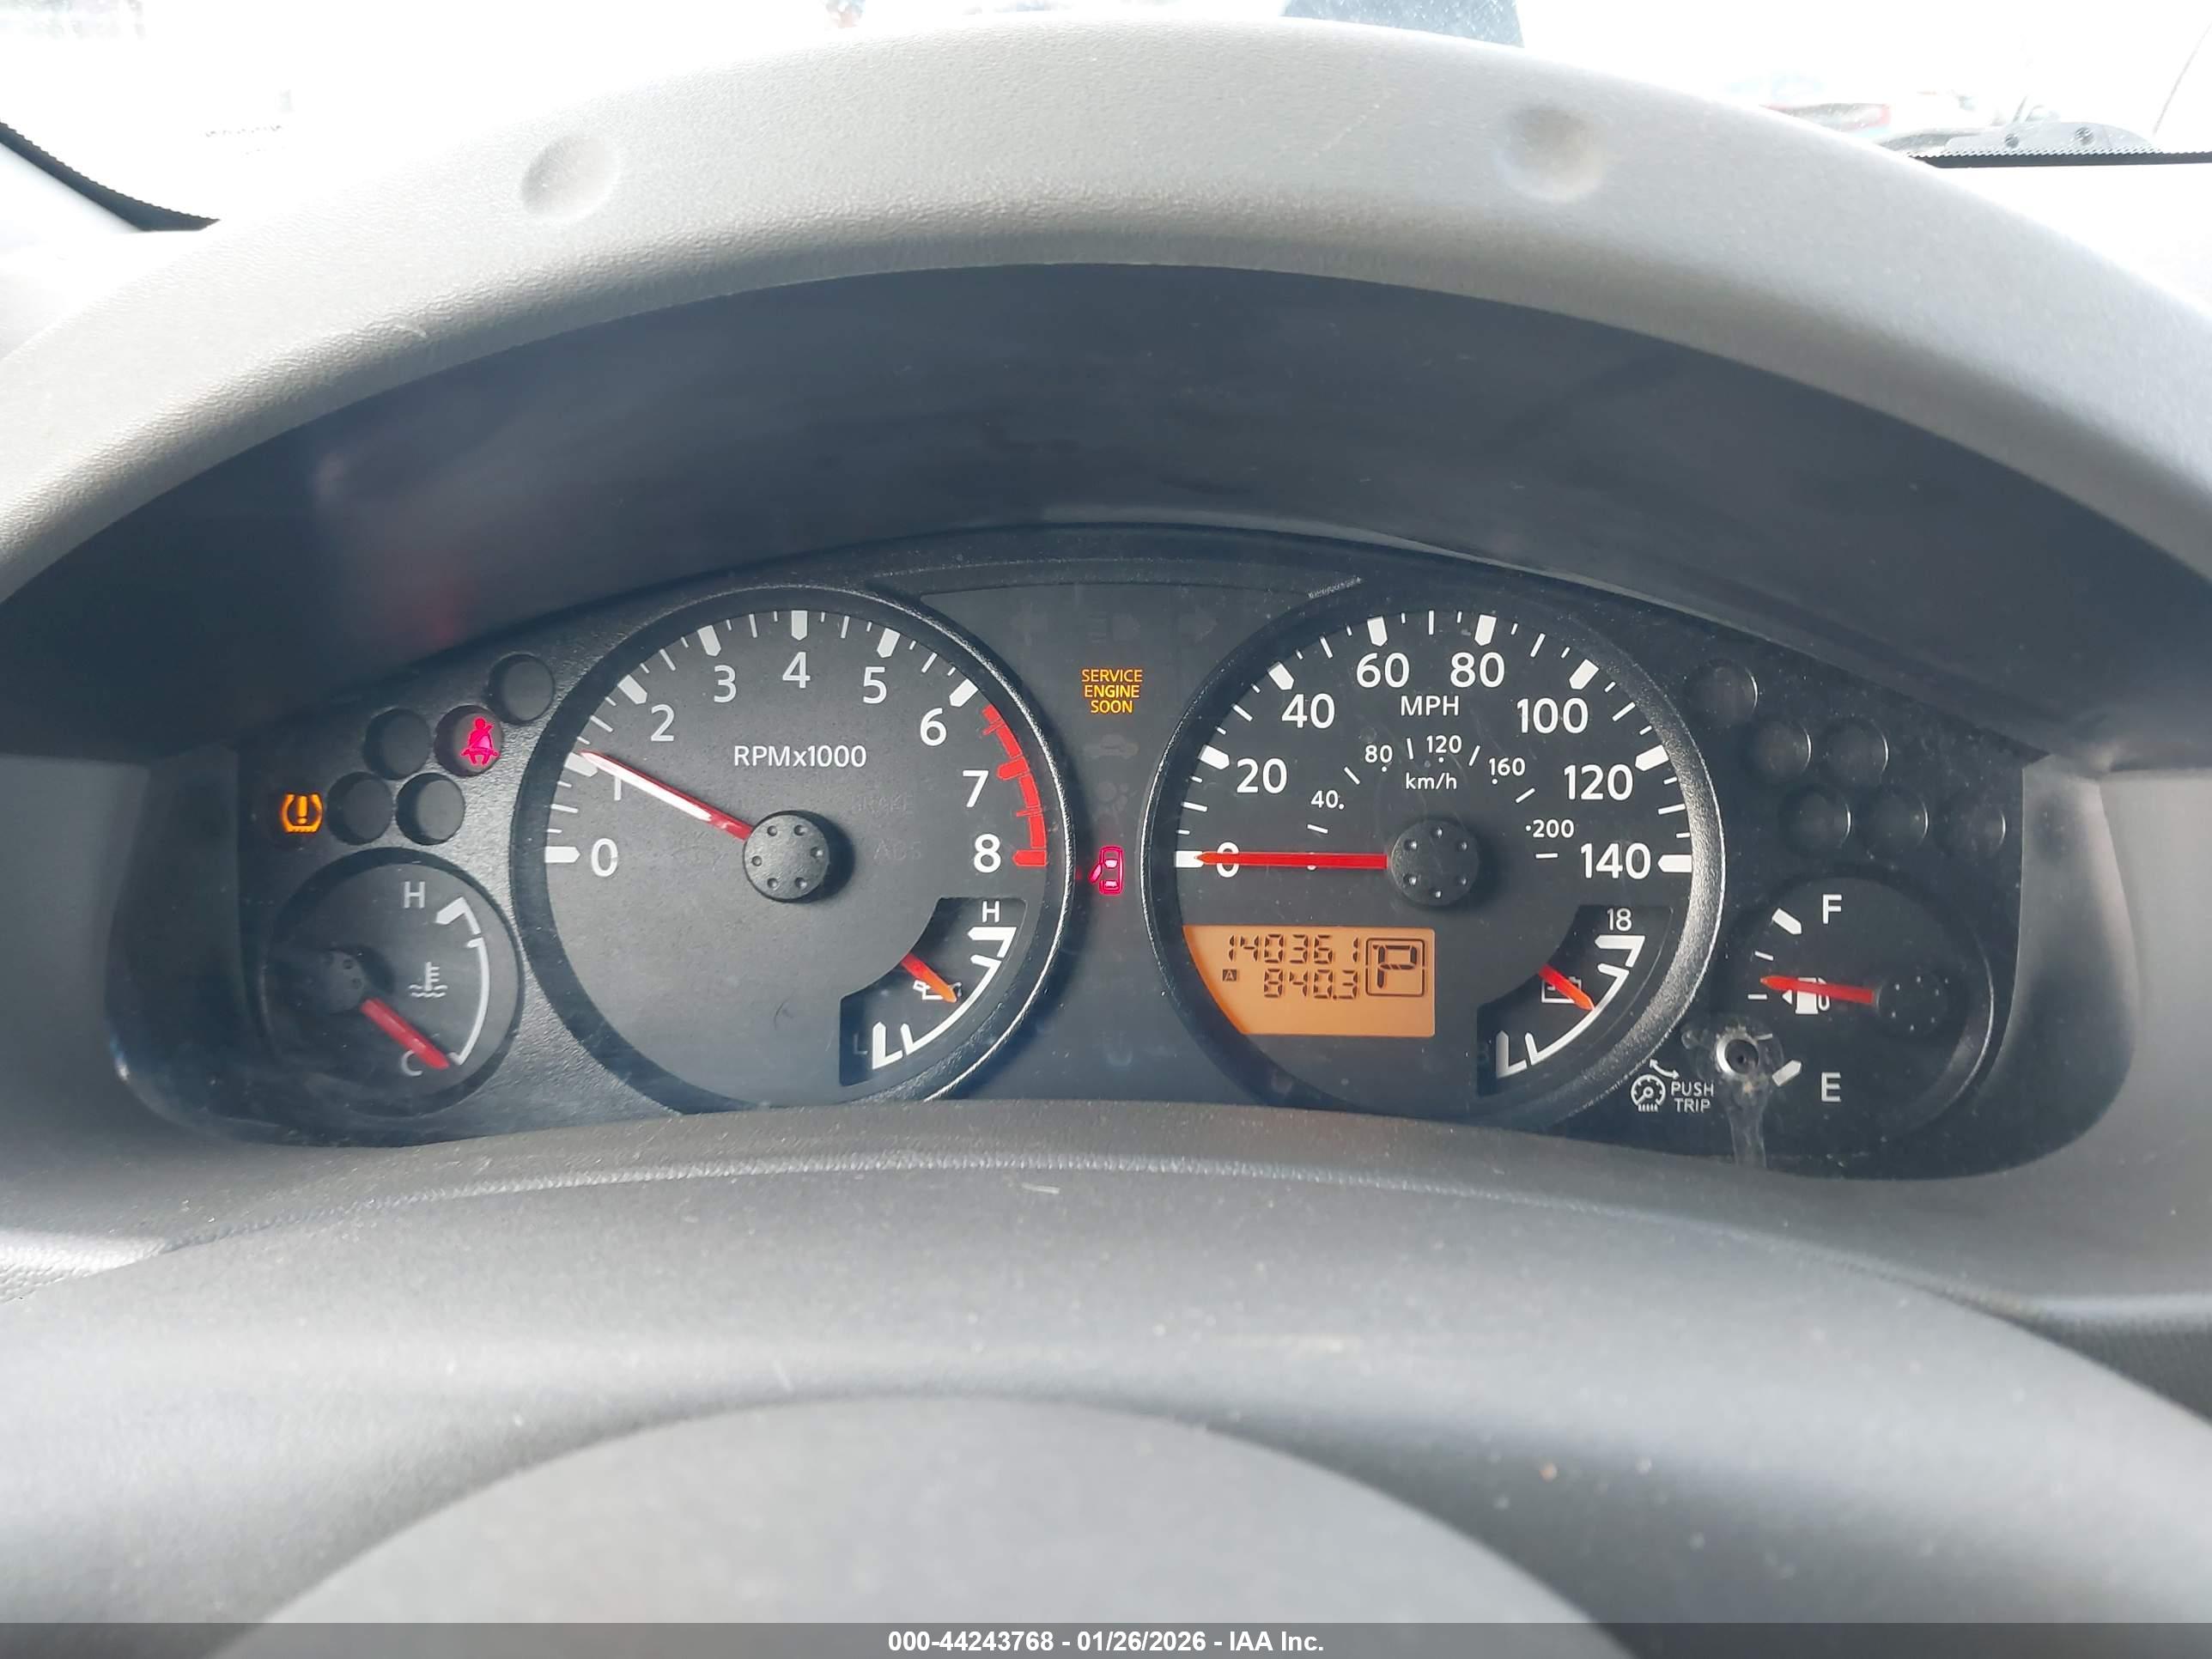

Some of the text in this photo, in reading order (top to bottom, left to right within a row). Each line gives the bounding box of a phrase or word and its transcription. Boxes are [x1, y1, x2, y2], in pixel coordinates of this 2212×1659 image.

[714, 665, 737, 703] 3
[781, 651, 811, 689] 4
[863, 666, 887, 704] 5
[1081, 669, 1143, 683] SERVICE
[1356, 652, 1410, 688] 60
[1450, 652, 1505, 688] 80
[1084, 684, 1140, 699] ENGINE
[1091, 699, 1133, 714] SOON
[1401, 695, 1459, 716] MPH
[650, 703, 675, 742] 2
[1281, 693, 1335, 729] 40
[1516, 697, 1589, 734] 100
[920, 708, 947, 746] 6
[734, 744, 866, 768] RPMx1000
[1364, 744, 1393, 763] 80
[1426, 734, 1462, 754] 120
[1237, 757, 1287, 794] 20
[1406, 772, 1457, 790] km/h
[1488, 757, 1526, 776] 160
[1564, 763, 1633, 801] 120
[963, 769, 989, 808] 7
[1533, 818, 1575, 838] 200
[590, 837, 618, 878] 0
[973, 833, 1001, 873] 8
[1580, 842, 1653, 880] 140
[404, 881, 426, 908] H
[1822, 894, 1843, 925] F
[981, 901, 1000, 923] H
[1607, 908, 1632, 932] 18
[1228, 933, 1358, 964] 140361
[1372, 945, 1418, 988] P
[1264, 968, 1358, 1000] 840.3
[1670, 1080, 1714, 1097] PUSH
[1820, 1072, 1841, 1103] E
[1674, 1097, 1711, 1114] TRIP
